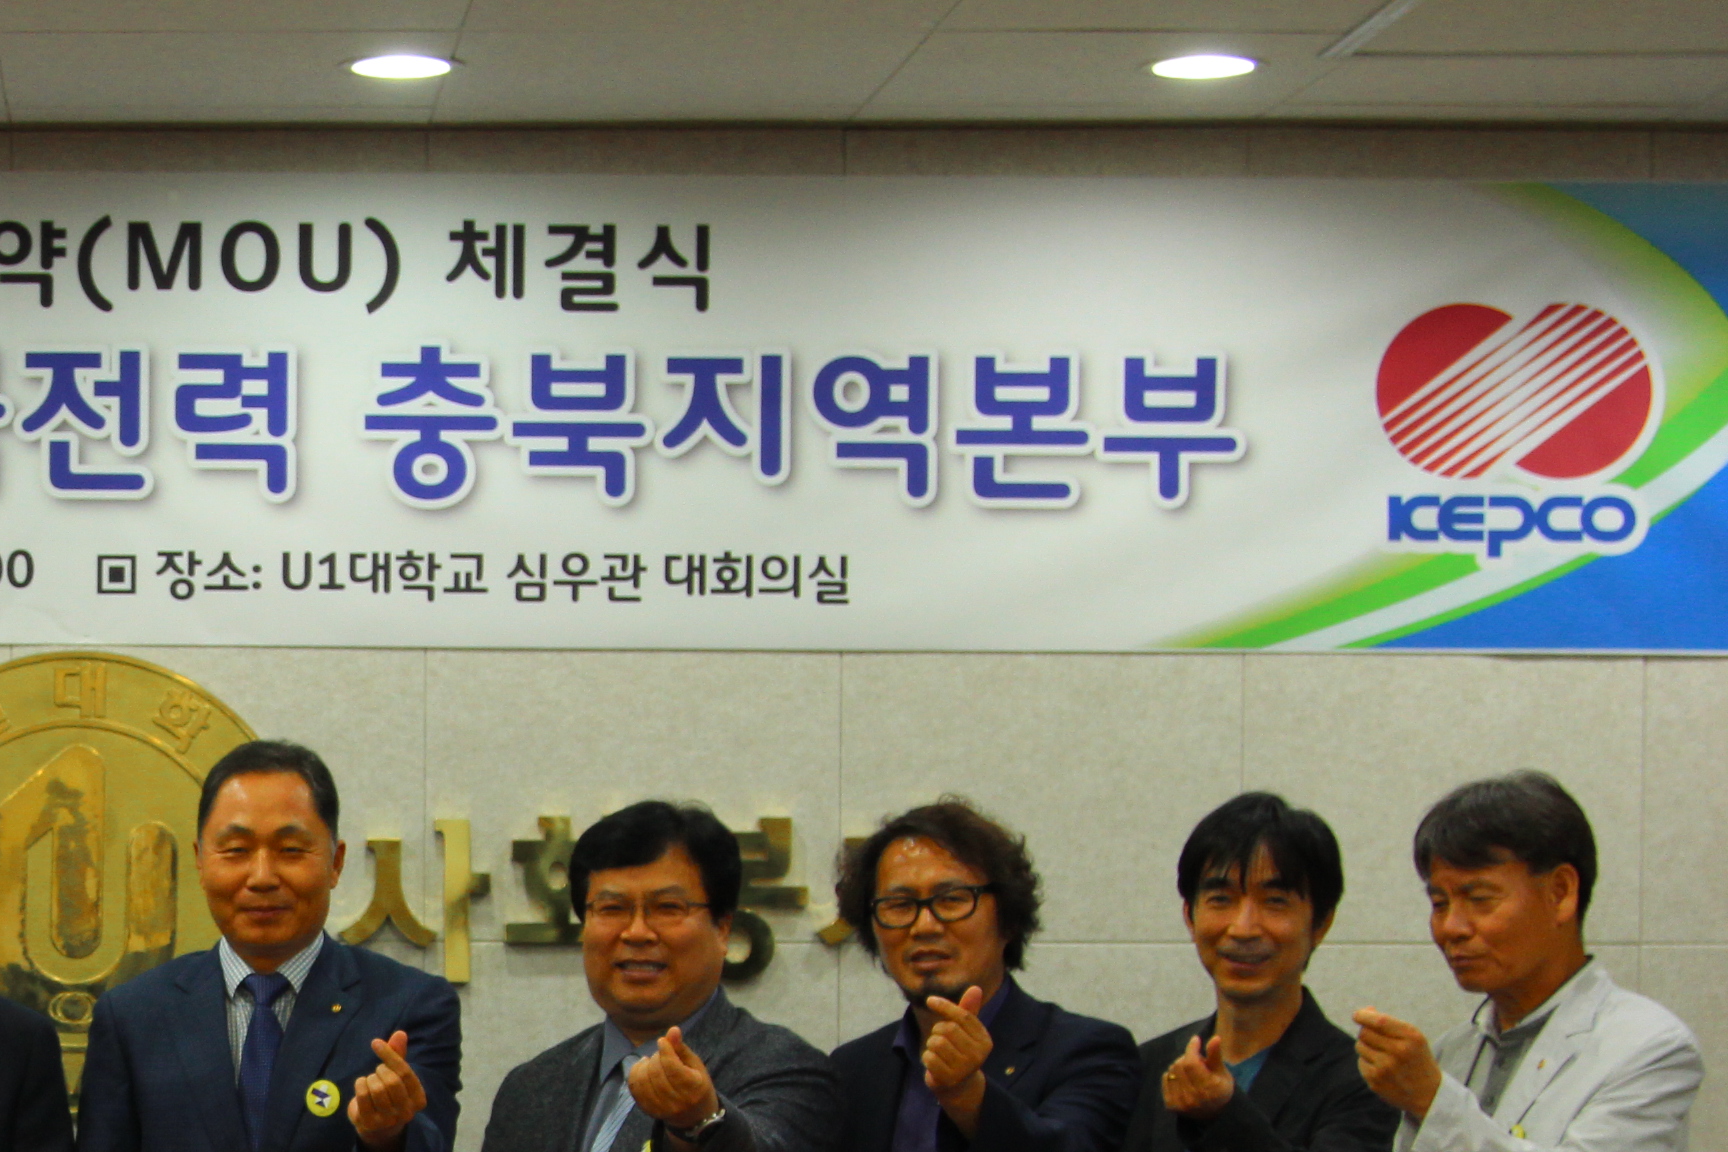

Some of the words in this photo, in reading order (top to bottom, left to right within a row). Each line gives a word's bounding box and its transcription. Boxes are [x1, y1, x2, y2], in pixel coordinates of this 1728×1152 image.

[448, 221, 712, 312] 체결식
[367, 348, 1237, 500] 충북지역본부
[1388, 493, 1637, 558] KEPCO
[158, 553, 261, 600] 장소:
[284, 552, 488, 601] U1대학교
[509, 554, 647, 602] 심우관
[666, 553, 849, 604] 대회의실
